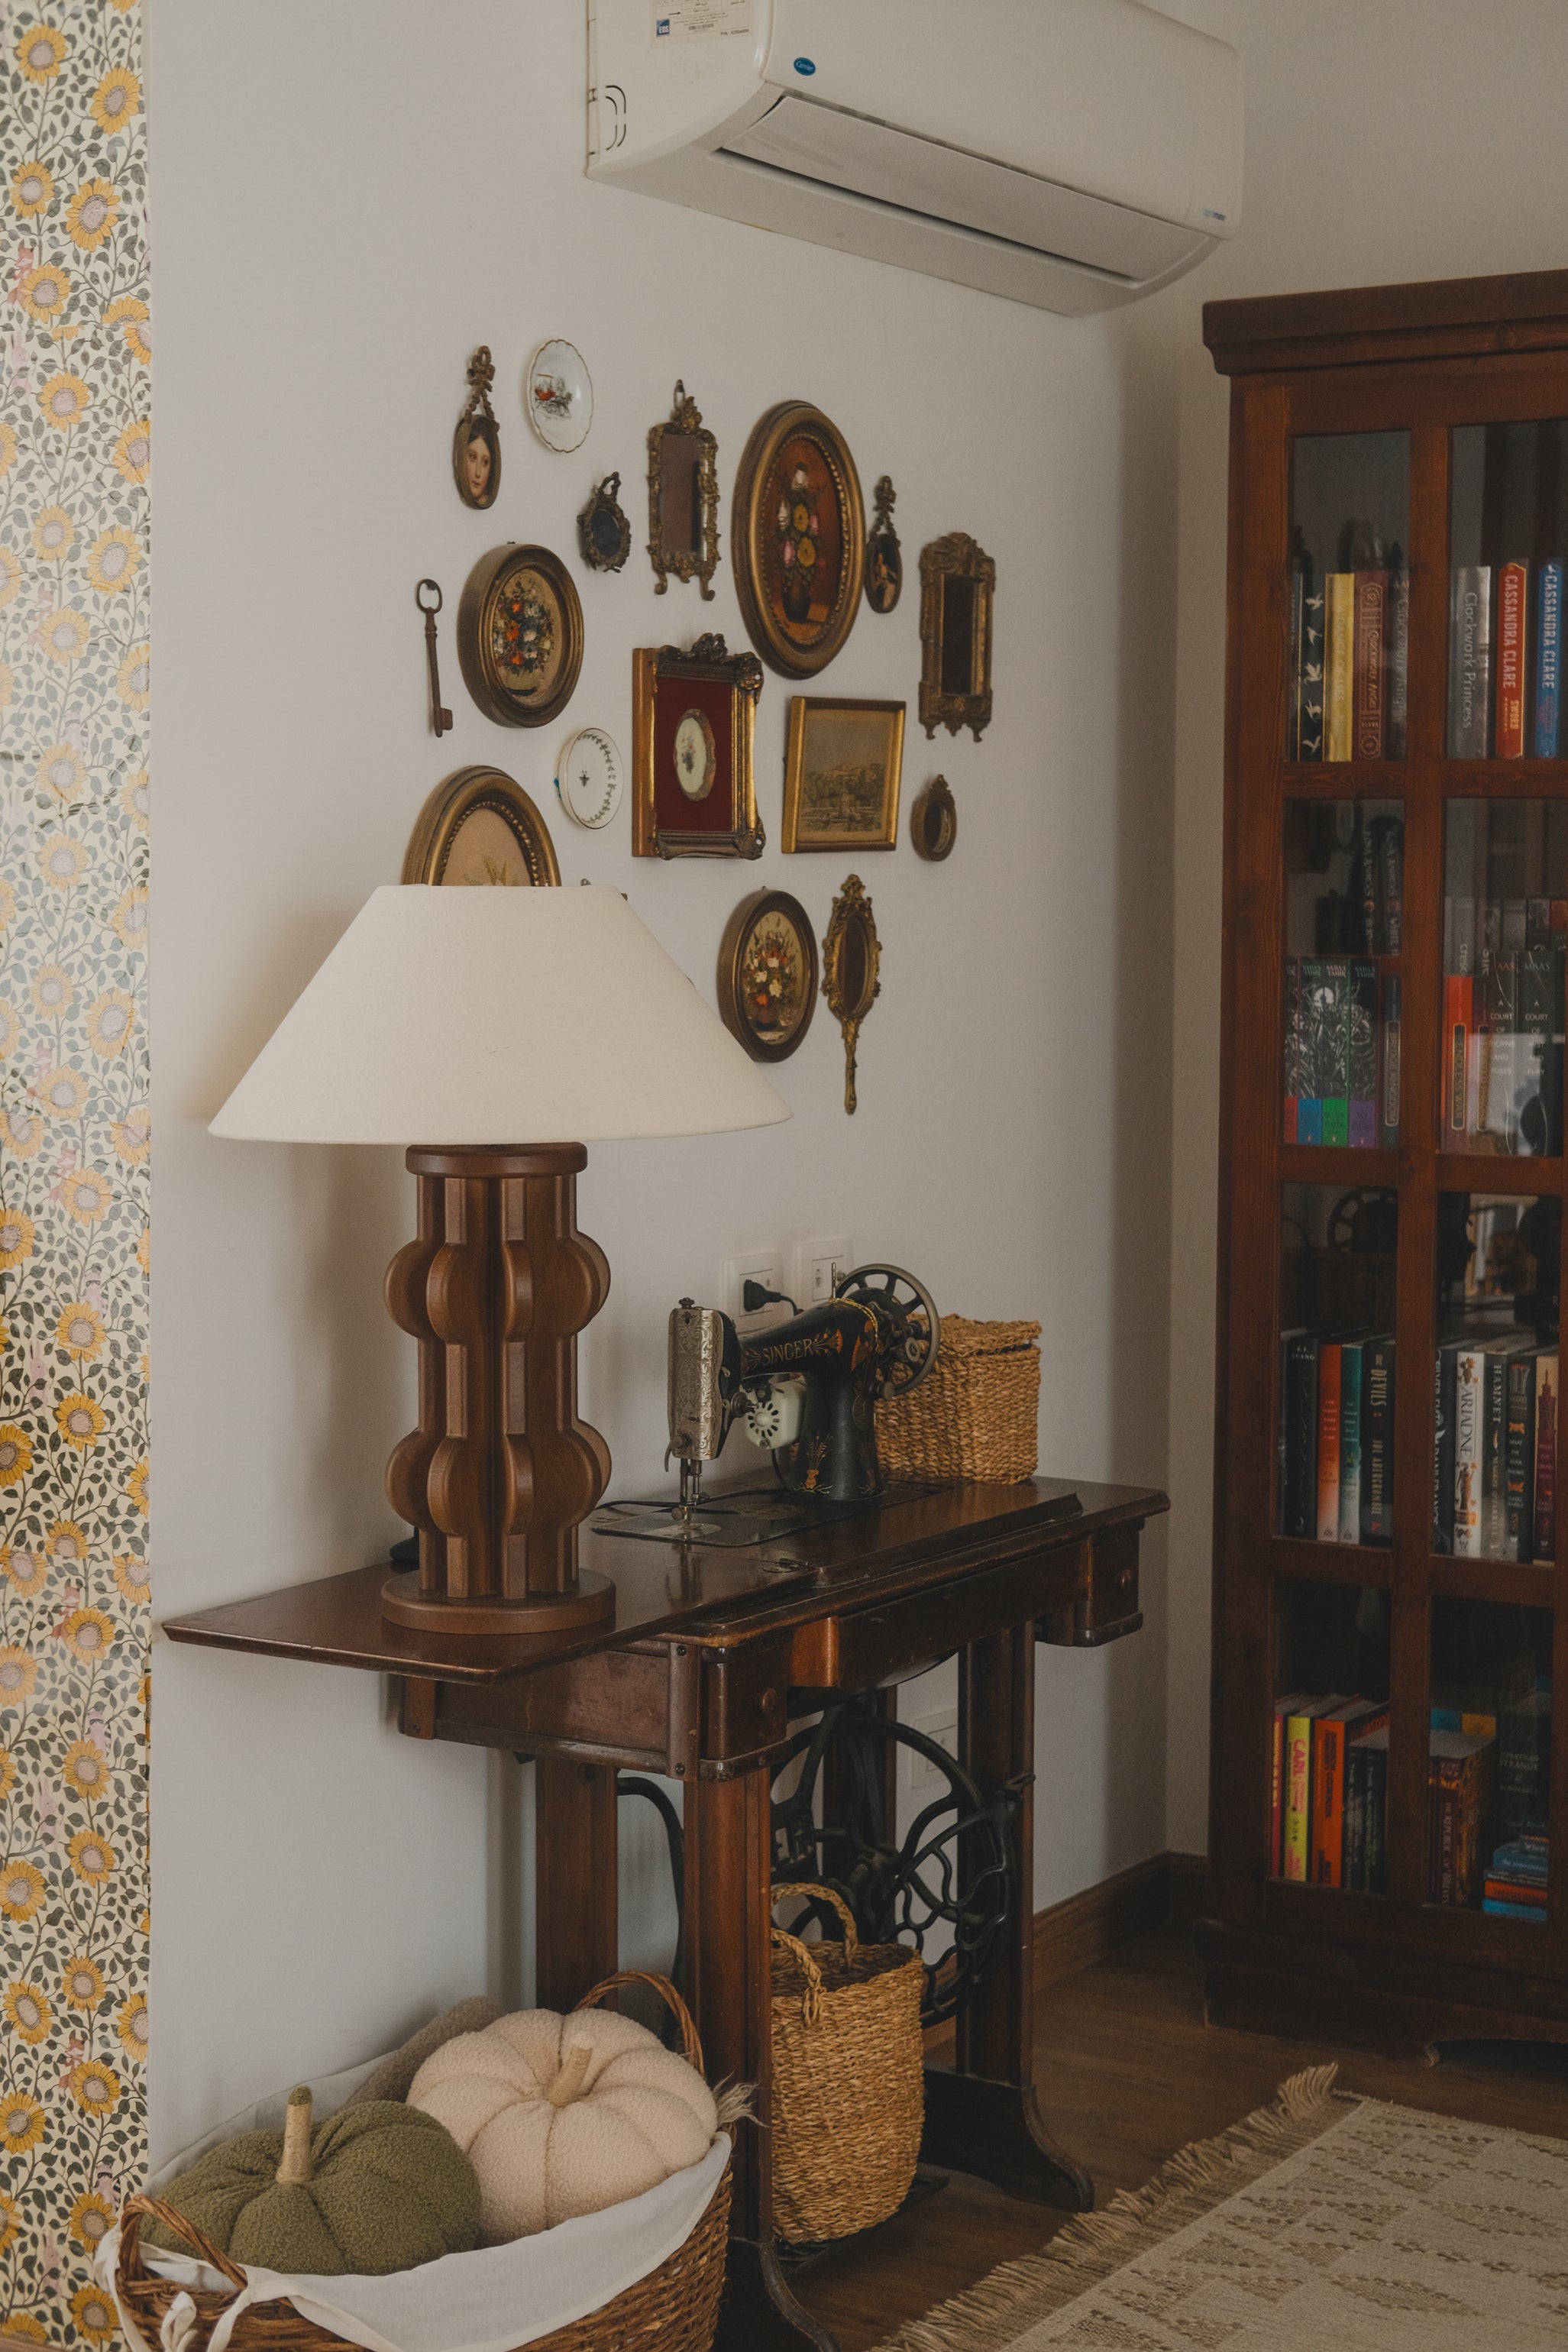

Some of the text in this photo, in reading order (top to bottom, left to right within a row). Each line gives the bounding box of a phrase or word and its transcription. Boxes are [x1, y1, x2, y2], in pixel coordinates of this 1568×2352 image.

[795, 60, 814, 73] Carrier
[1503, 574, 1518, 647] CASSANDRA
[1542, 574, 1557, 646] CASSANDRA
[1463, 591, 1478, 729] Clockwork Princess
[1502, 650, 1517, 689] CLARE
[1541, 650, 1557, 689] CLARE
[1524, 962, 1551, 972] MAAS
[1490, 1013, 1513, 1021] COURT
[1524, 1013, 1549, 1021] COURT
[1534, 999, 1540, 1008] A
[1454, 1042, 1463, 1119] ENDLESS WAR
[1527, 1068, 1545, 1076] FURY
[762, 1338, 814, 1367] SINGER
[1370, 1368, 1388, 1407] DEVILS
[1492, 1364, 1502, 1424] HAMNET
[1460, 1387, 1474, 1460] ARIADNE
[1371, 1439, 1383, 1454] JOE
